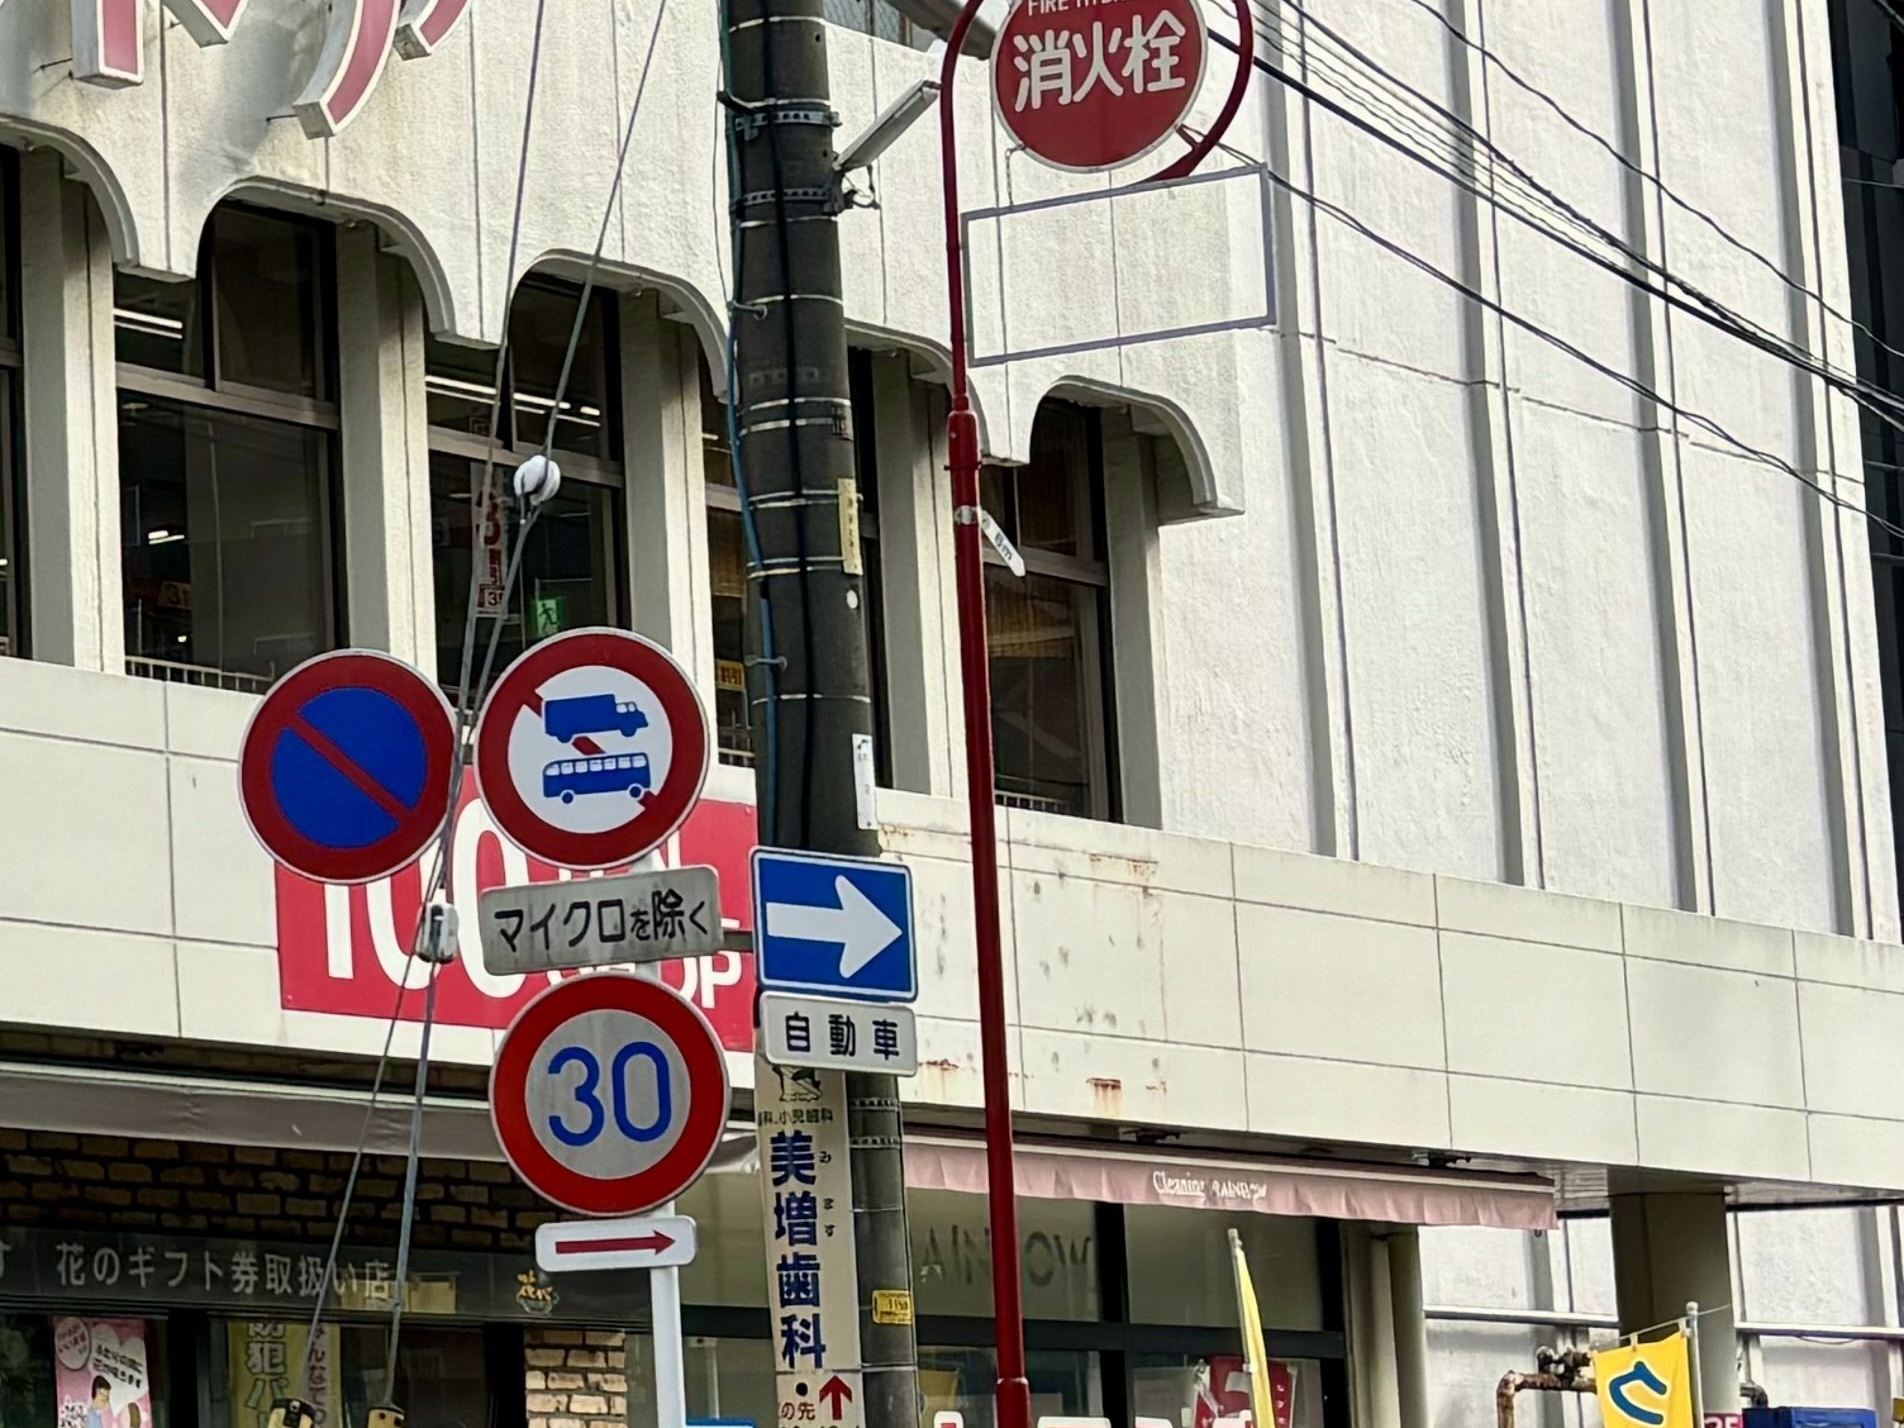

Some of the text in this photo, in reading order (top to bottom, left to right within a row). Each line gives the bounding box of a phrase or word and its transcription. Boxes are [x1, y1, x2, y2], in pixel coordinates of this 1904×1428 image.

[1013, 10, 1185, 113] 消火栓
[494, 888, 709, 953] マイクロを除く
[784, 1010, 900, 1062] 自動車
[548, 1041, 672, 1147] 30
[1152, 1170, 1206, 1198] Cleaning
[57, 1238, 393, 1303] 花のギフト券取扱い店
[770, 1130, 827, 1370] 美増歯科
